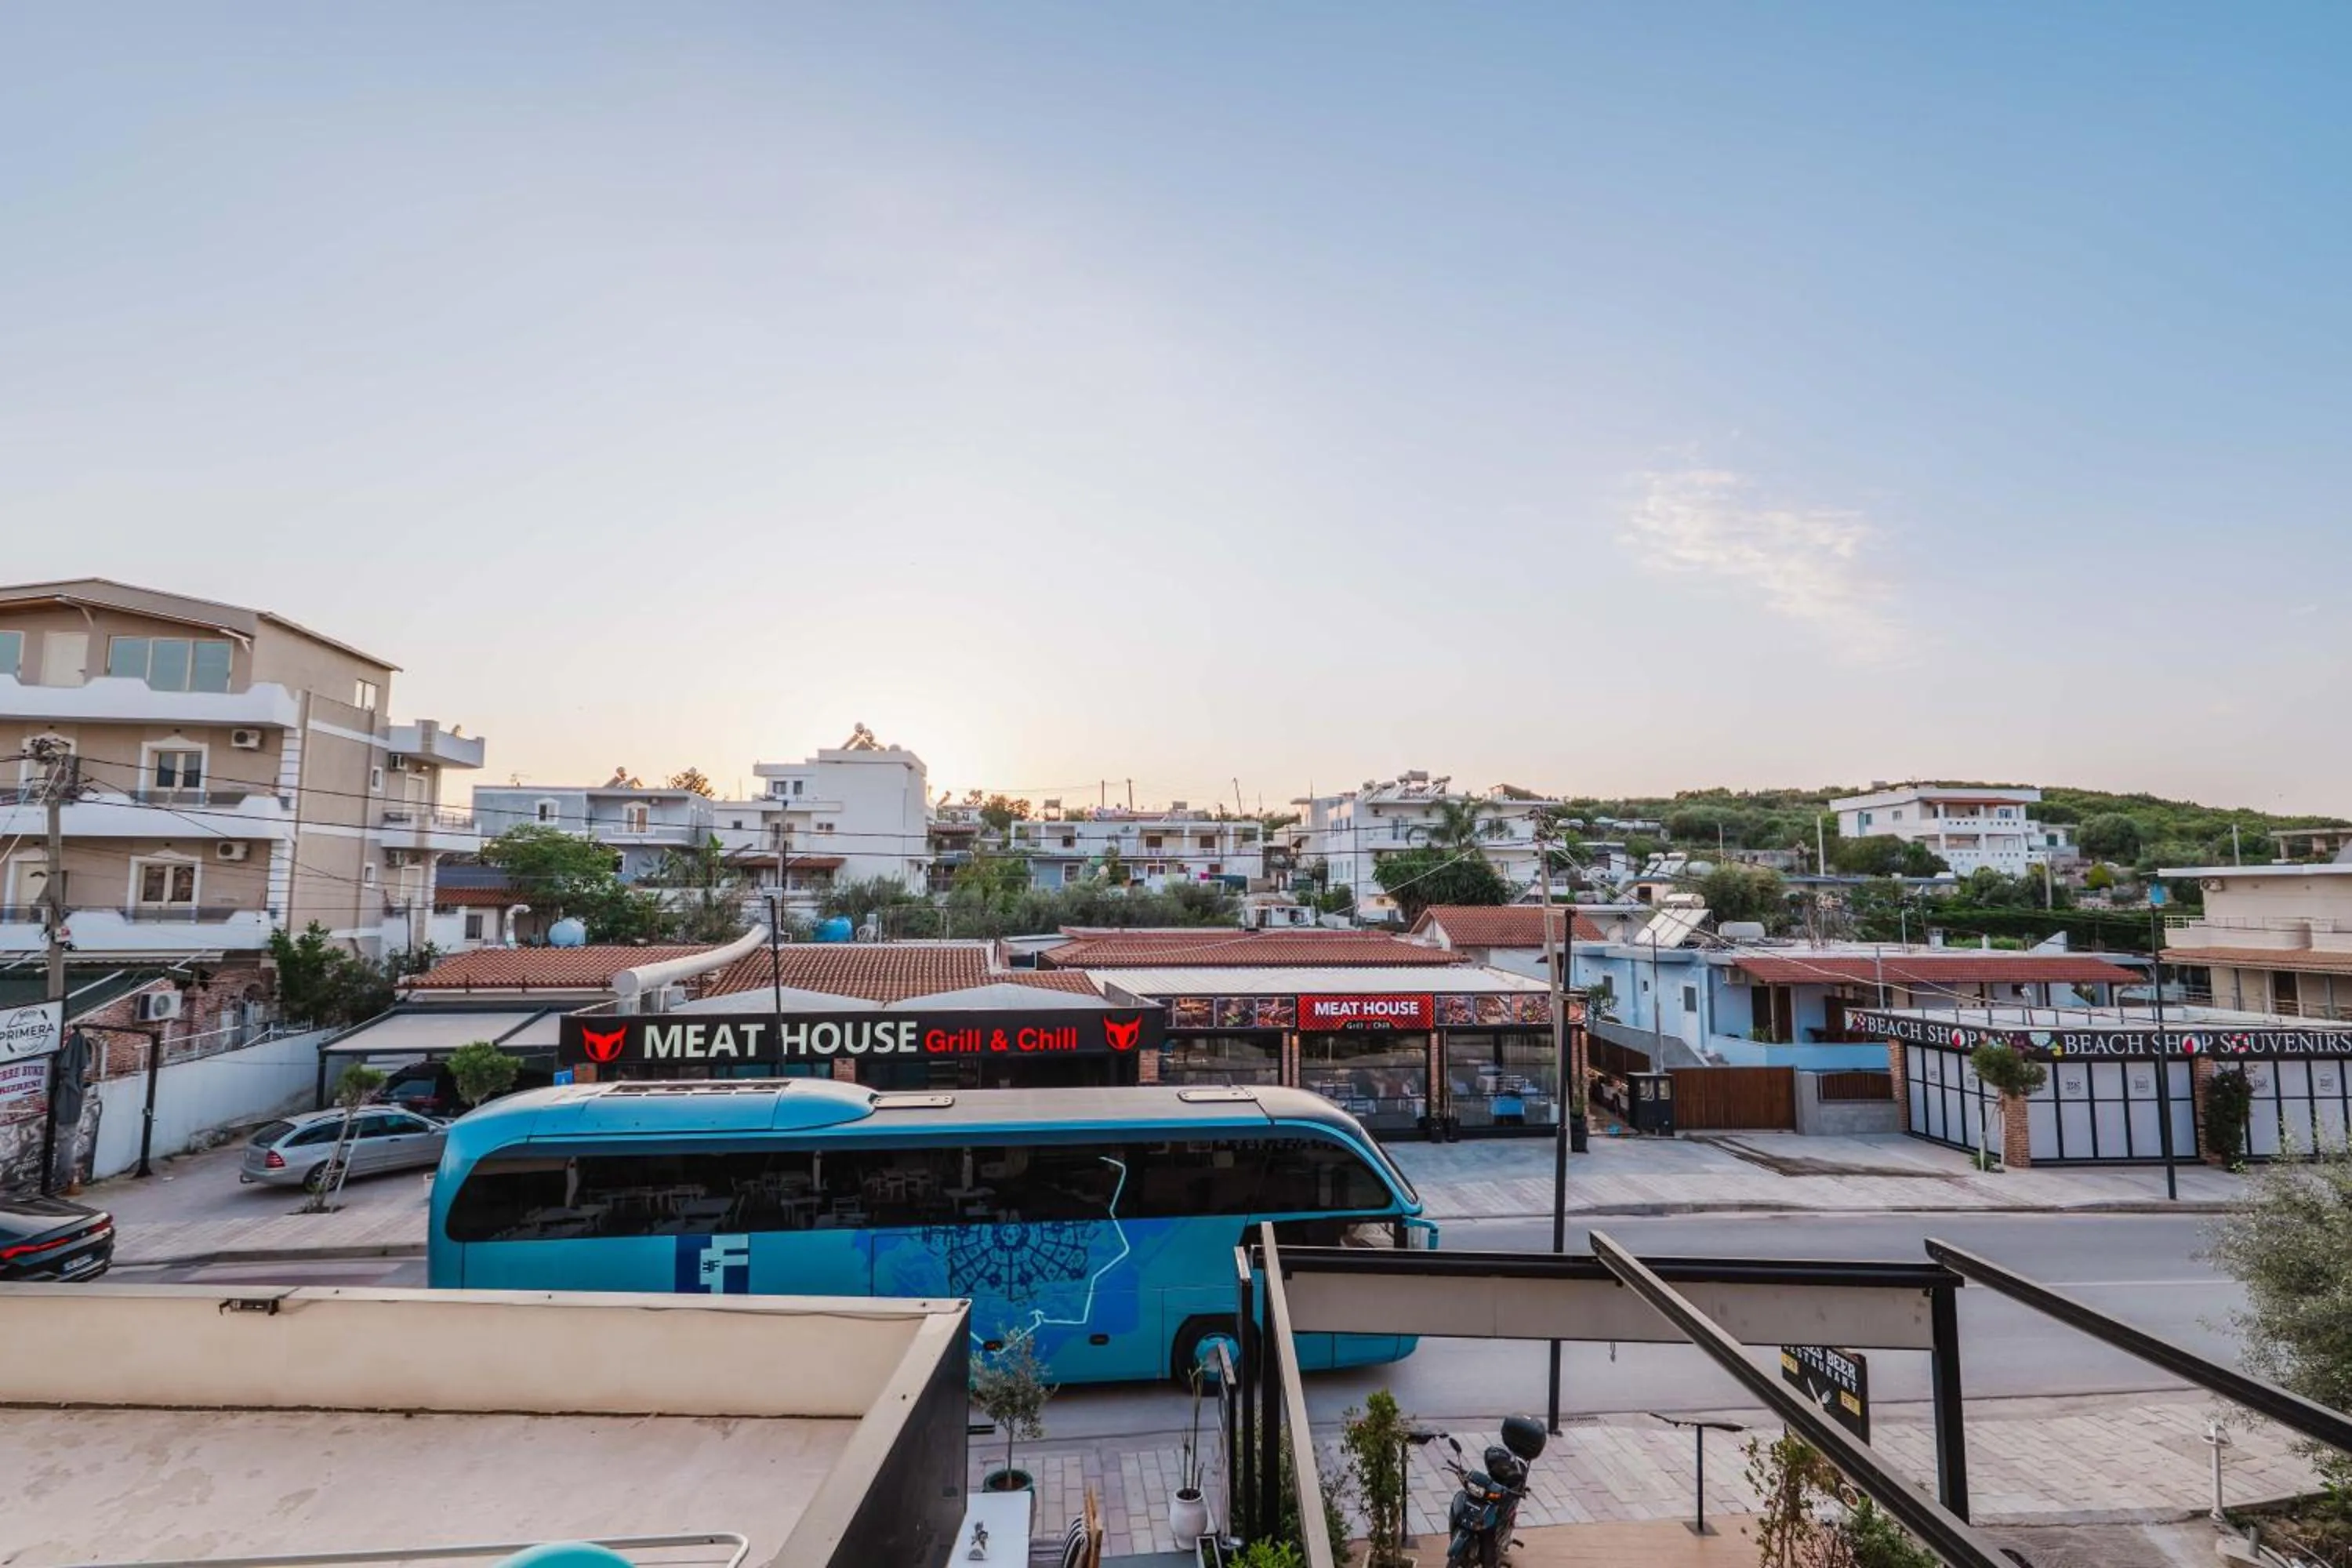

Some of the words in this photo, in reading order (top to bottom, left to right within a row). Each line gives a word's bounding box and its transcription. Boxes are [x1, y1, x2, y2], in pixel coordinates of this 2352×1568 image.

[1314, 1001, 1359, 1016] MEAT
[1363, 1001, 1420, 1016] HOUSE
[0, 1022, 56, 1041] PRIMERA
[644, 1024, 766, 1059] MEAT
[782, 1021, 918, 1056] HOUSE
[924, 1027, 980, 1052] Grill
[990, 1028, 1009, 1052] &
[1017, 1025, 1077, 1051] Chill
[1867, 1015, 1923, 1040] BEACH
[1927, 1025, 1977, 1048] SHOP
[2063, 1033, 2146, 1054] BEACH
[2151, 1033, 2214, 1055] SHOP
[2220, 1033, 2352, 1054] SOUVENIRS
[1825, 1347, 1856, 1381] BEER
